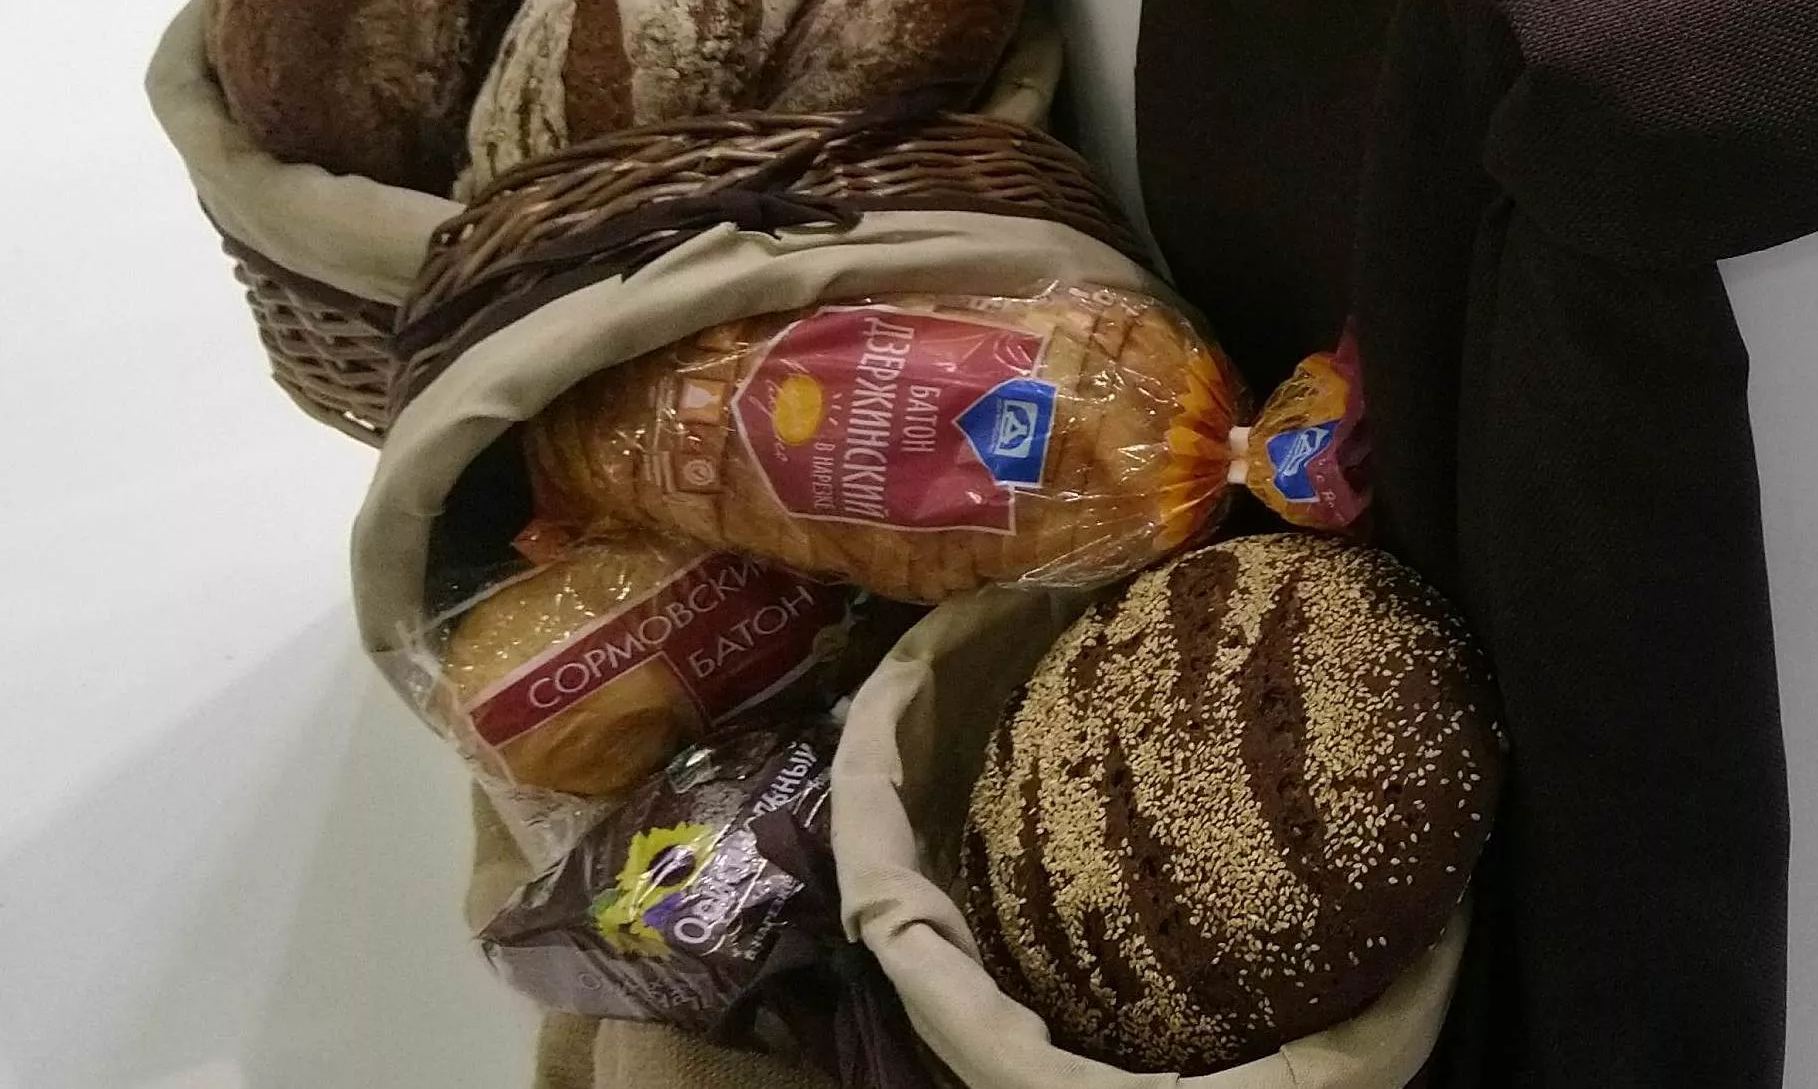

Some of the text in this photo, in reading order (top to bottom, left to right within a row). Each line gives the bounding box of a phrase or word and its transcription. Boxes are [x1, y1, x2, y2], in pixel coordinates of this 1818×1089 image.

[841, 316, 916, 519] ДЗЕРЖИНСКИЙ
[902, 385, 942, 453] БАТОН
[811, 456, 836, 510] НАРЕЗКЕ
[528, 560, 761, 709] СОРМОВСКИ
[688, 585, 815, 678] БАТОН
